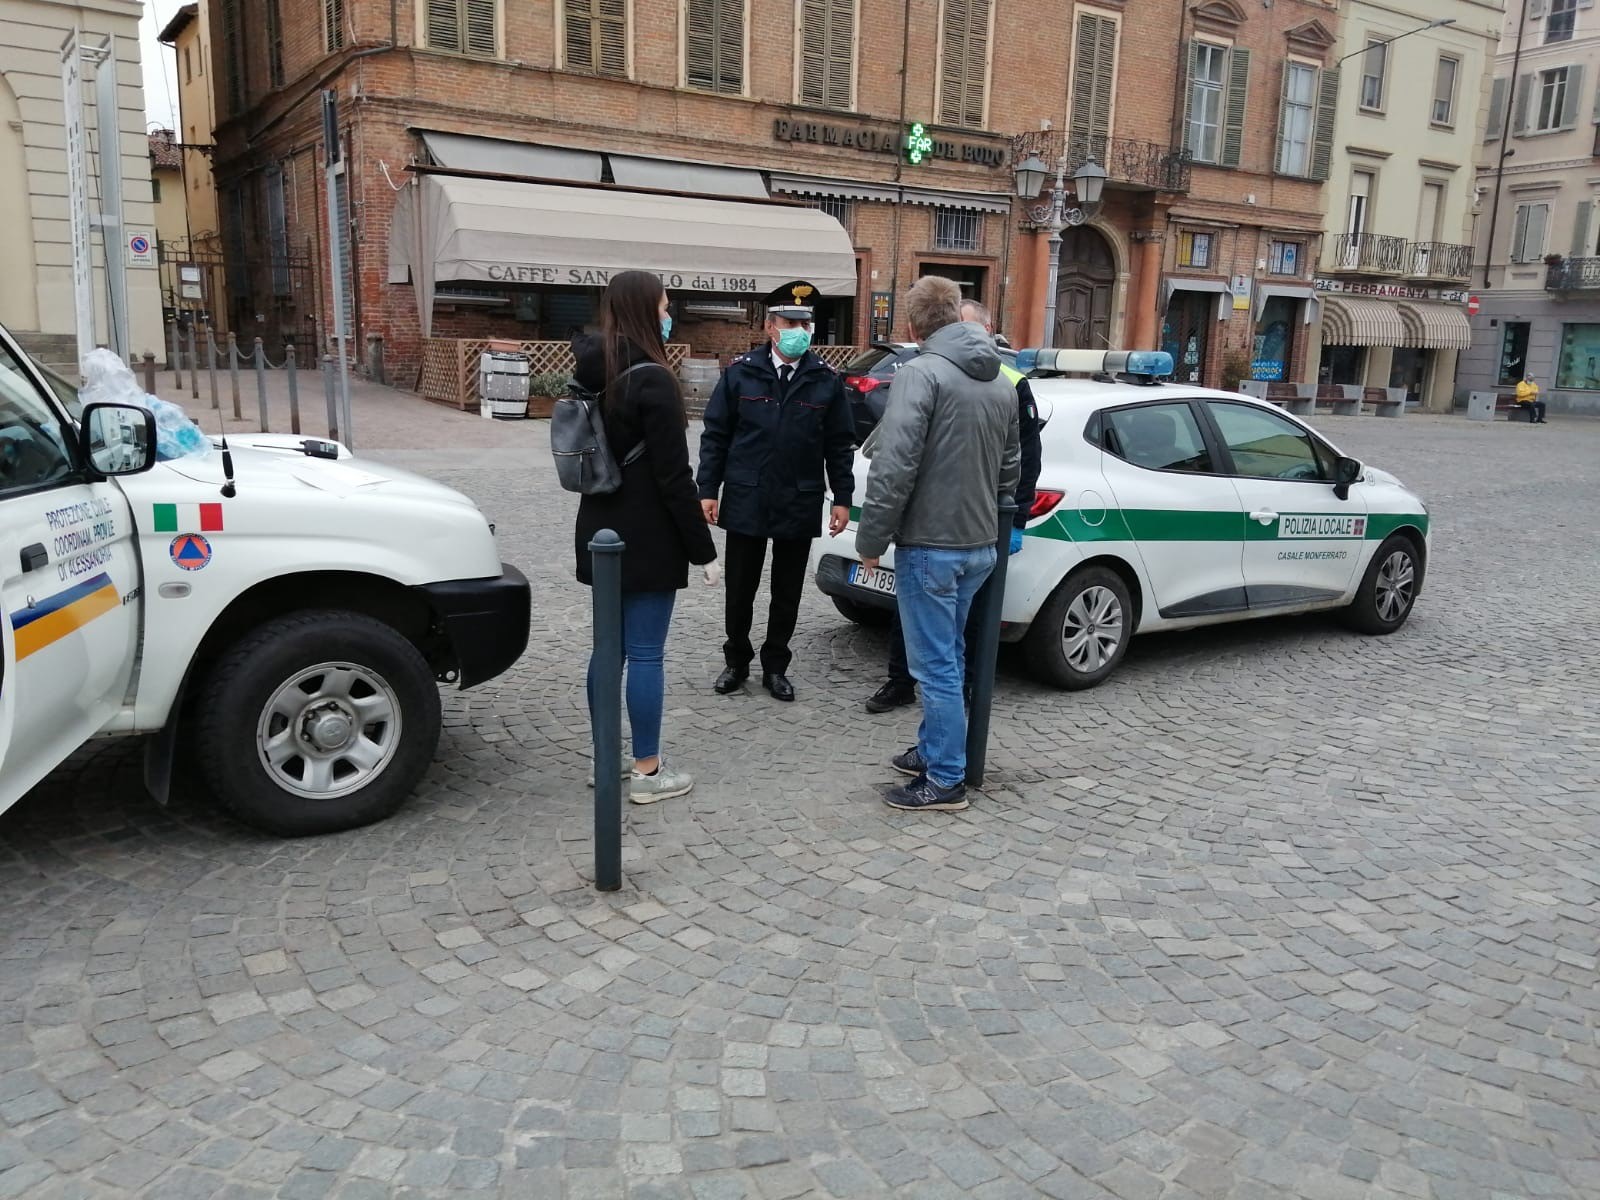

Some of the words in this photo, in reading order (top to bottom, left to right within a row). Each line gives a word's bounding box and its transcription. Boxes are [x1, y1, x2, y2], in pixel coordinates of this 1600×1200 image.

[775, 119, 896, 154] FARMACIA
[908, 136, 932, 152] FAR
[487, 265, 559, 283] CAFFE'
[568, 269, 609, 285] SAN
[691, 275, 716, 290] dal
[721, 277, 757, 292] 1984
[1342, 281, 1430, 299] FERRAMENTA
[45, 502, 93, 531] PROTEZIONE
[1283, 517, 1317, 535] POLIZIA
[1318, 517, 1353, 535] LOCALE
[1277, 551, 1304, 561] CASALE
[1304, 551, 1348, 561] MONFERRATO
